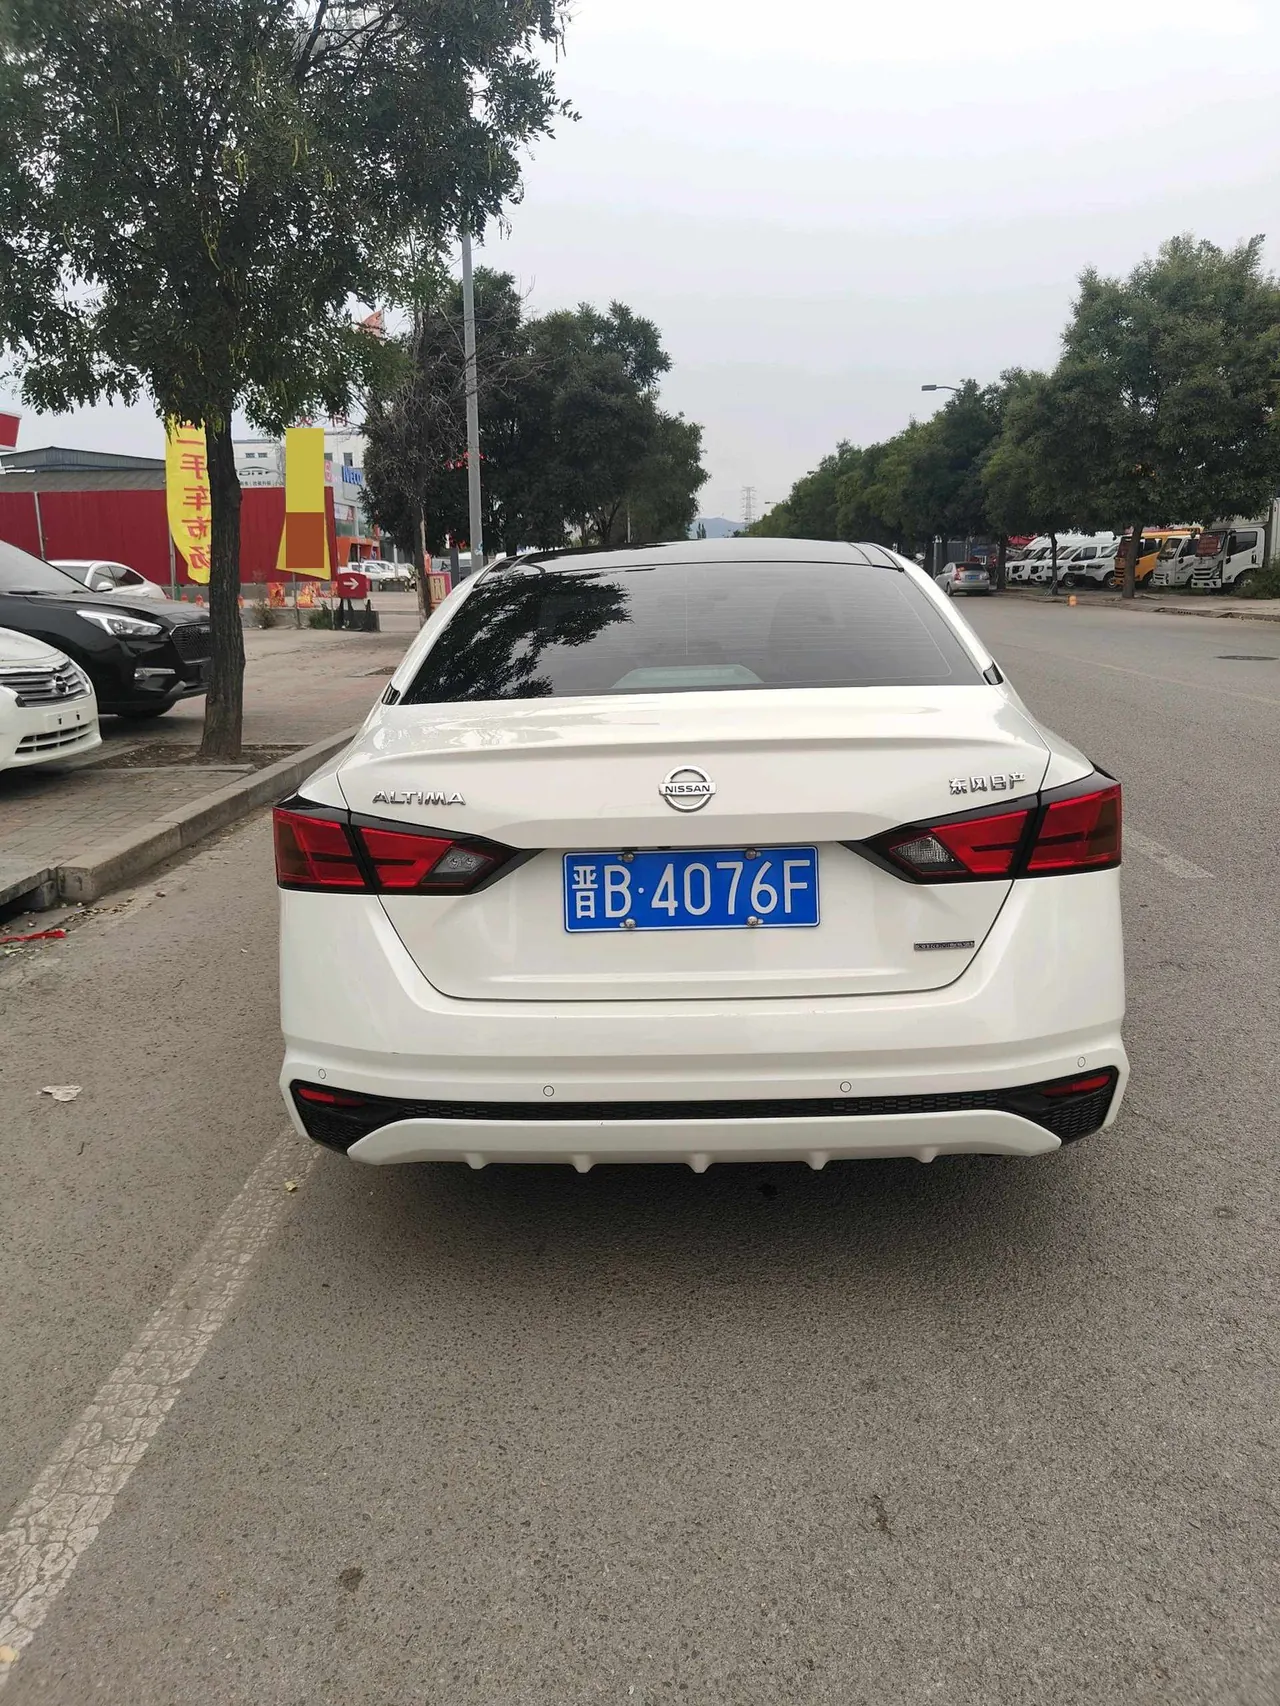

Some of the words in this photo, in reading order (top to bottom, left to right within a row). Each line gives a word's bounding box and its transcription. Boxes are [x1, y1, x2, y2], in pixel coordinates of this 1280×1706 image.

[664, 784, 711, 793] NISSAN
[949, 772, 1025, 795] 东风日产
[372, 790, 466, 805] ALTIMA
[571, 859, 811, 919] 晋B·4076F
